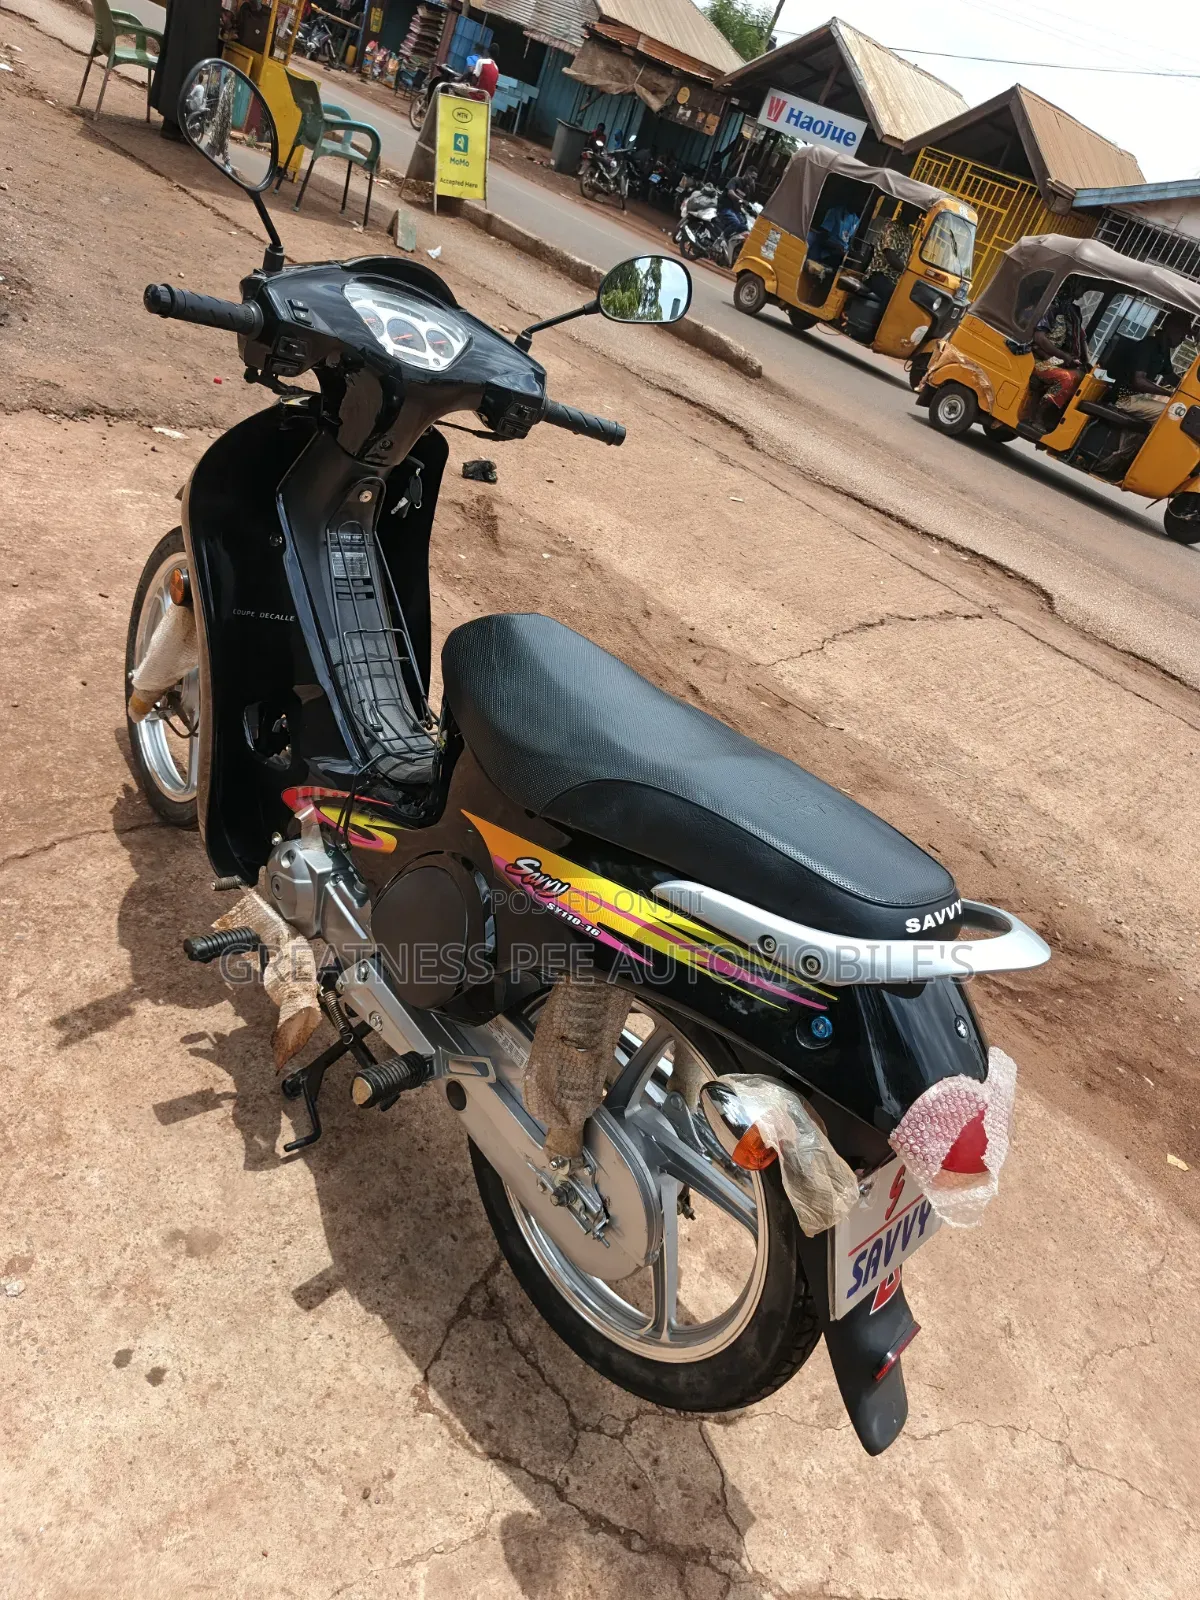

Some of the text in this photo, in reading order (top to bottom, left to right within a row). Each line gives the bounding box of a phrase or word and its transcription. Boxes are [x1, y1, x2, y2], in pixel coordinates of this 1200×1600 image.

[785, 107, 857, 147] Haojue
[449, 156, 470, 167] MoMo
[440, 177, 478, 189] Accepted Here
[232, 608, 296, 622] COUPE DECALLE
[546, 902, 601, 938] SY110-16
[905, 898, 963, 934] SAVVY
[846, 1199, 932, 1299] SAVVY
